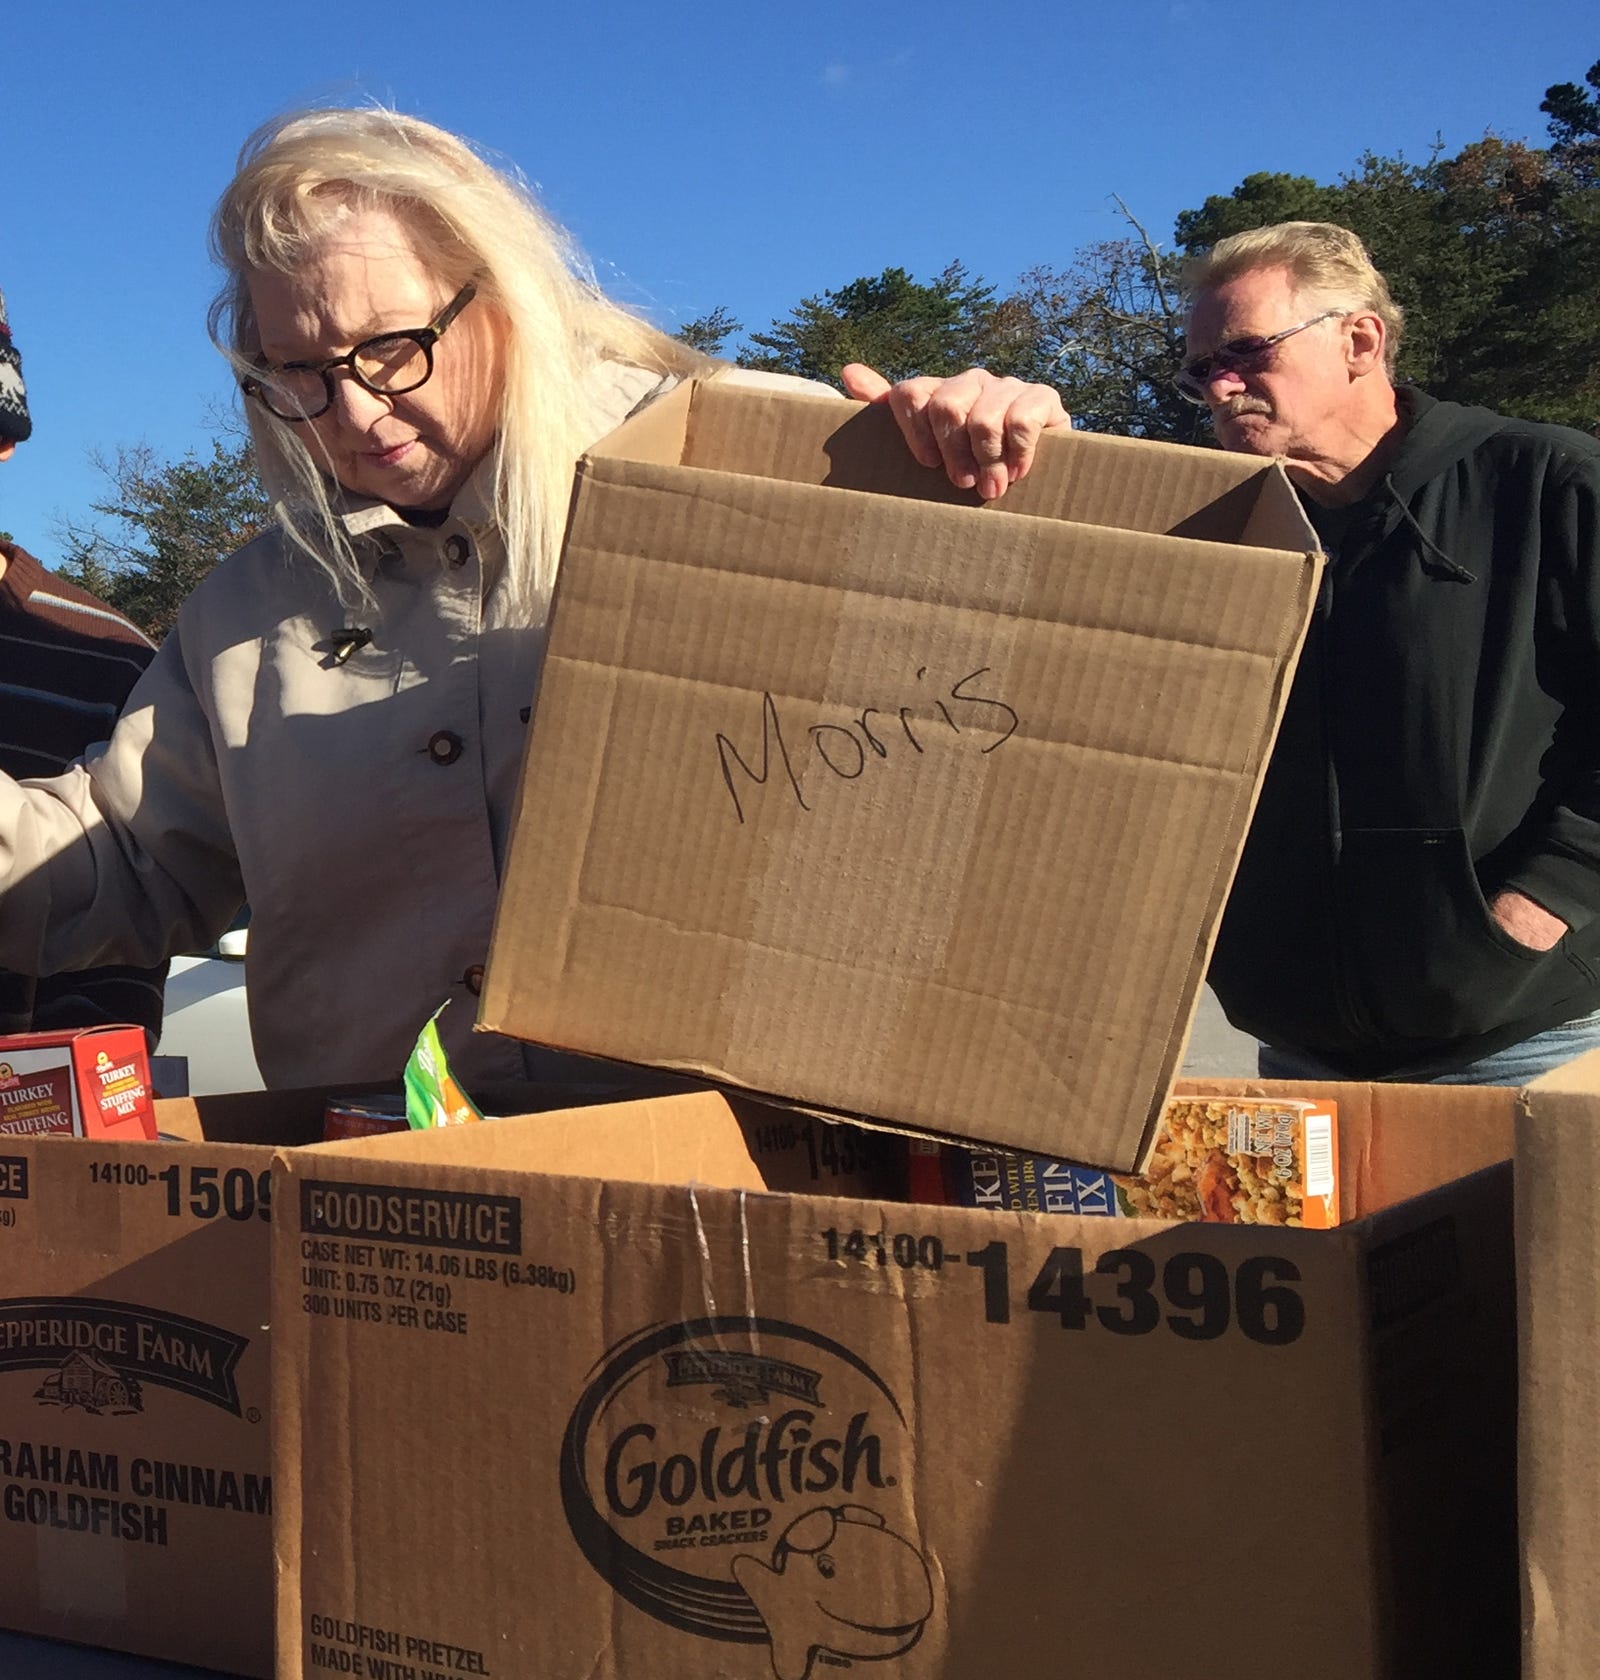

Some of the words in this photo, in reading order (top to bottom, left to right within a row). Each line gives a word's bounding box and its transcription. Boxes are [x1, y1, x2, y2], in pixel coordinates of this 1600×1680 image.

[715, 667, 1019, 824] Morris
[99, 1063, 136, 1085] TURKEY
[100, 1086, 145, 1111] STUFFING
[116, 1101, 136, 1117] MIX
[0, 1112, 69, 1135] STUFFING
[309, 1189, 511, 1246] FOODSERVICE
[301, 1240, 340, 1263] CASE
[344, 1244, 375, 1268] NET
[379, 1248, 410, 1271] WT:
[415, 1252, 461, 1277] 14.06
[465, 1257, 497, 1282] LBS
[502, 1260, 576, 1295] (6.38kg)
[302, 1267, 341, 1290] UNIT:
[345, 1271, 379, 1296] 0.75
[383, 1275, 405, 1298] OZ
[410, 1279, 452, 1309] (21g)
[302, 1294, 329, 1316] 300
[334, 1297, 381, 1323] UNITS
[387, 1304, 419, 1328] PER
[424, 1308, 467, 1334] CASE
[136, 1322, 214, 1380] FARM
[4, 1484, 168, 1546] GOLDFISH
[666, 1508, 772, 1536] BAKED
[654, 1537, 696, 1551] SNACK
[700, 1530, 768, 1547] CRACKERS
[311, 1613, 401, 1656] GOLDFISH
[406, 1636, 490, 1676] PRETZEL
[311, 1643, 363, 1676] MADE
[367, 1656, 416, 1680] WITH
